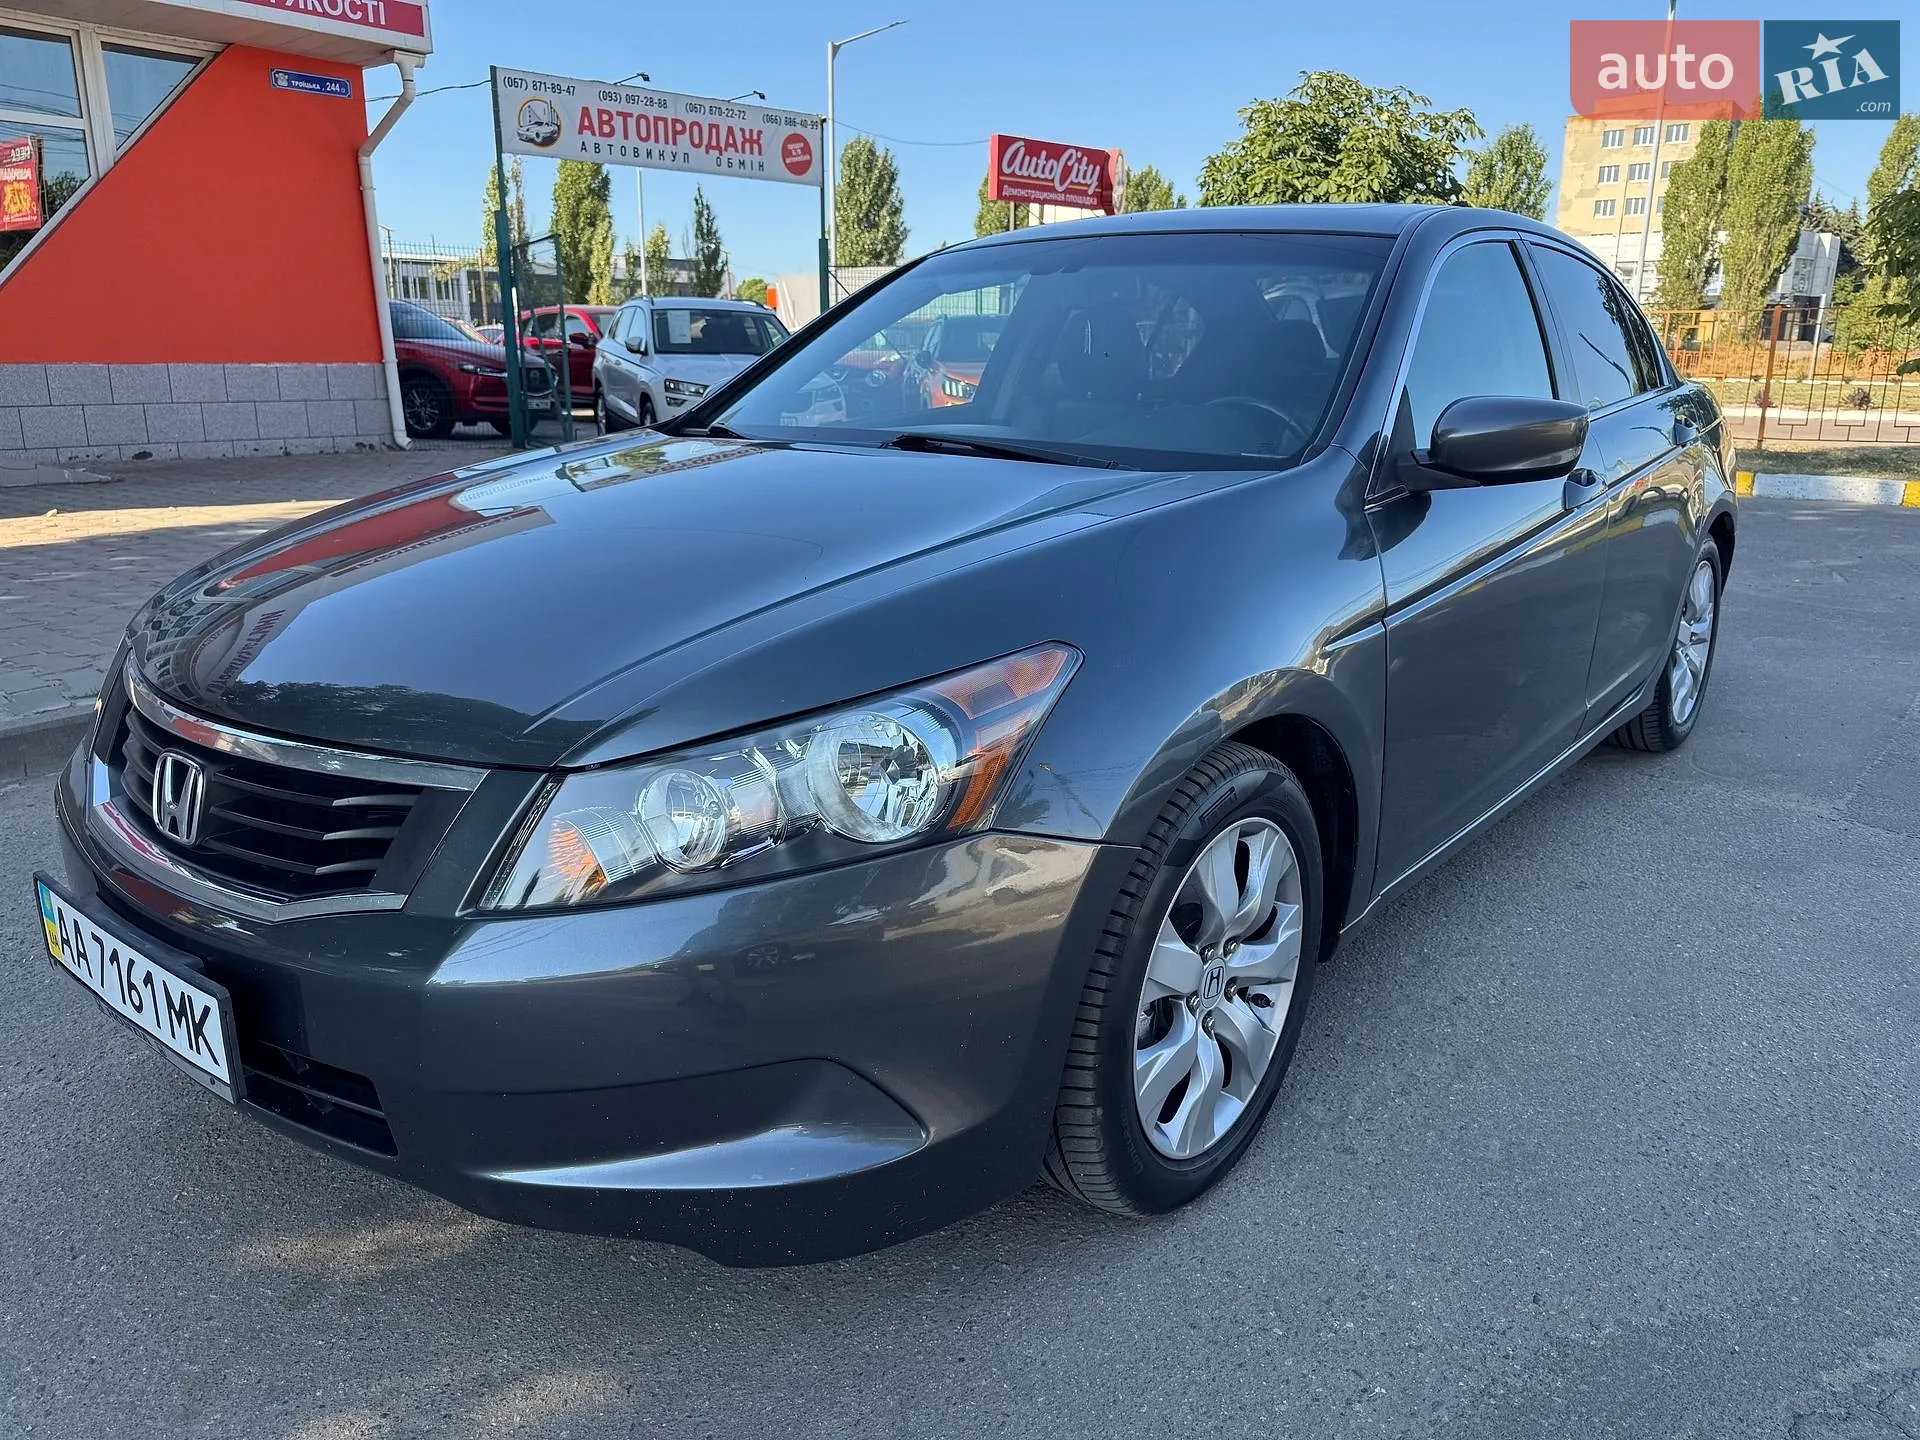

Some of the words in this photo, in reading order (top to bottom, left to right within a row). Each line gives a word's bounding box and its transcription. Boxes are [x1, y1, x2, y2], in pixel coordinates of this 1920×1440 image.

[326, 82, 340, 92] 244
[532, 80, 576, 97] 871-89-47
[598, 90, 622, 104] (093)
[625, 93, 668, 109] 097-28-88
[709, 105, 747, 120] 870-22-72
[578, 106, 764, 157] АВТОПРОДАЖ
[580, 141, 690, 164] АВТОВИКУП
[716, 156, 765, 172] ОБМІН
